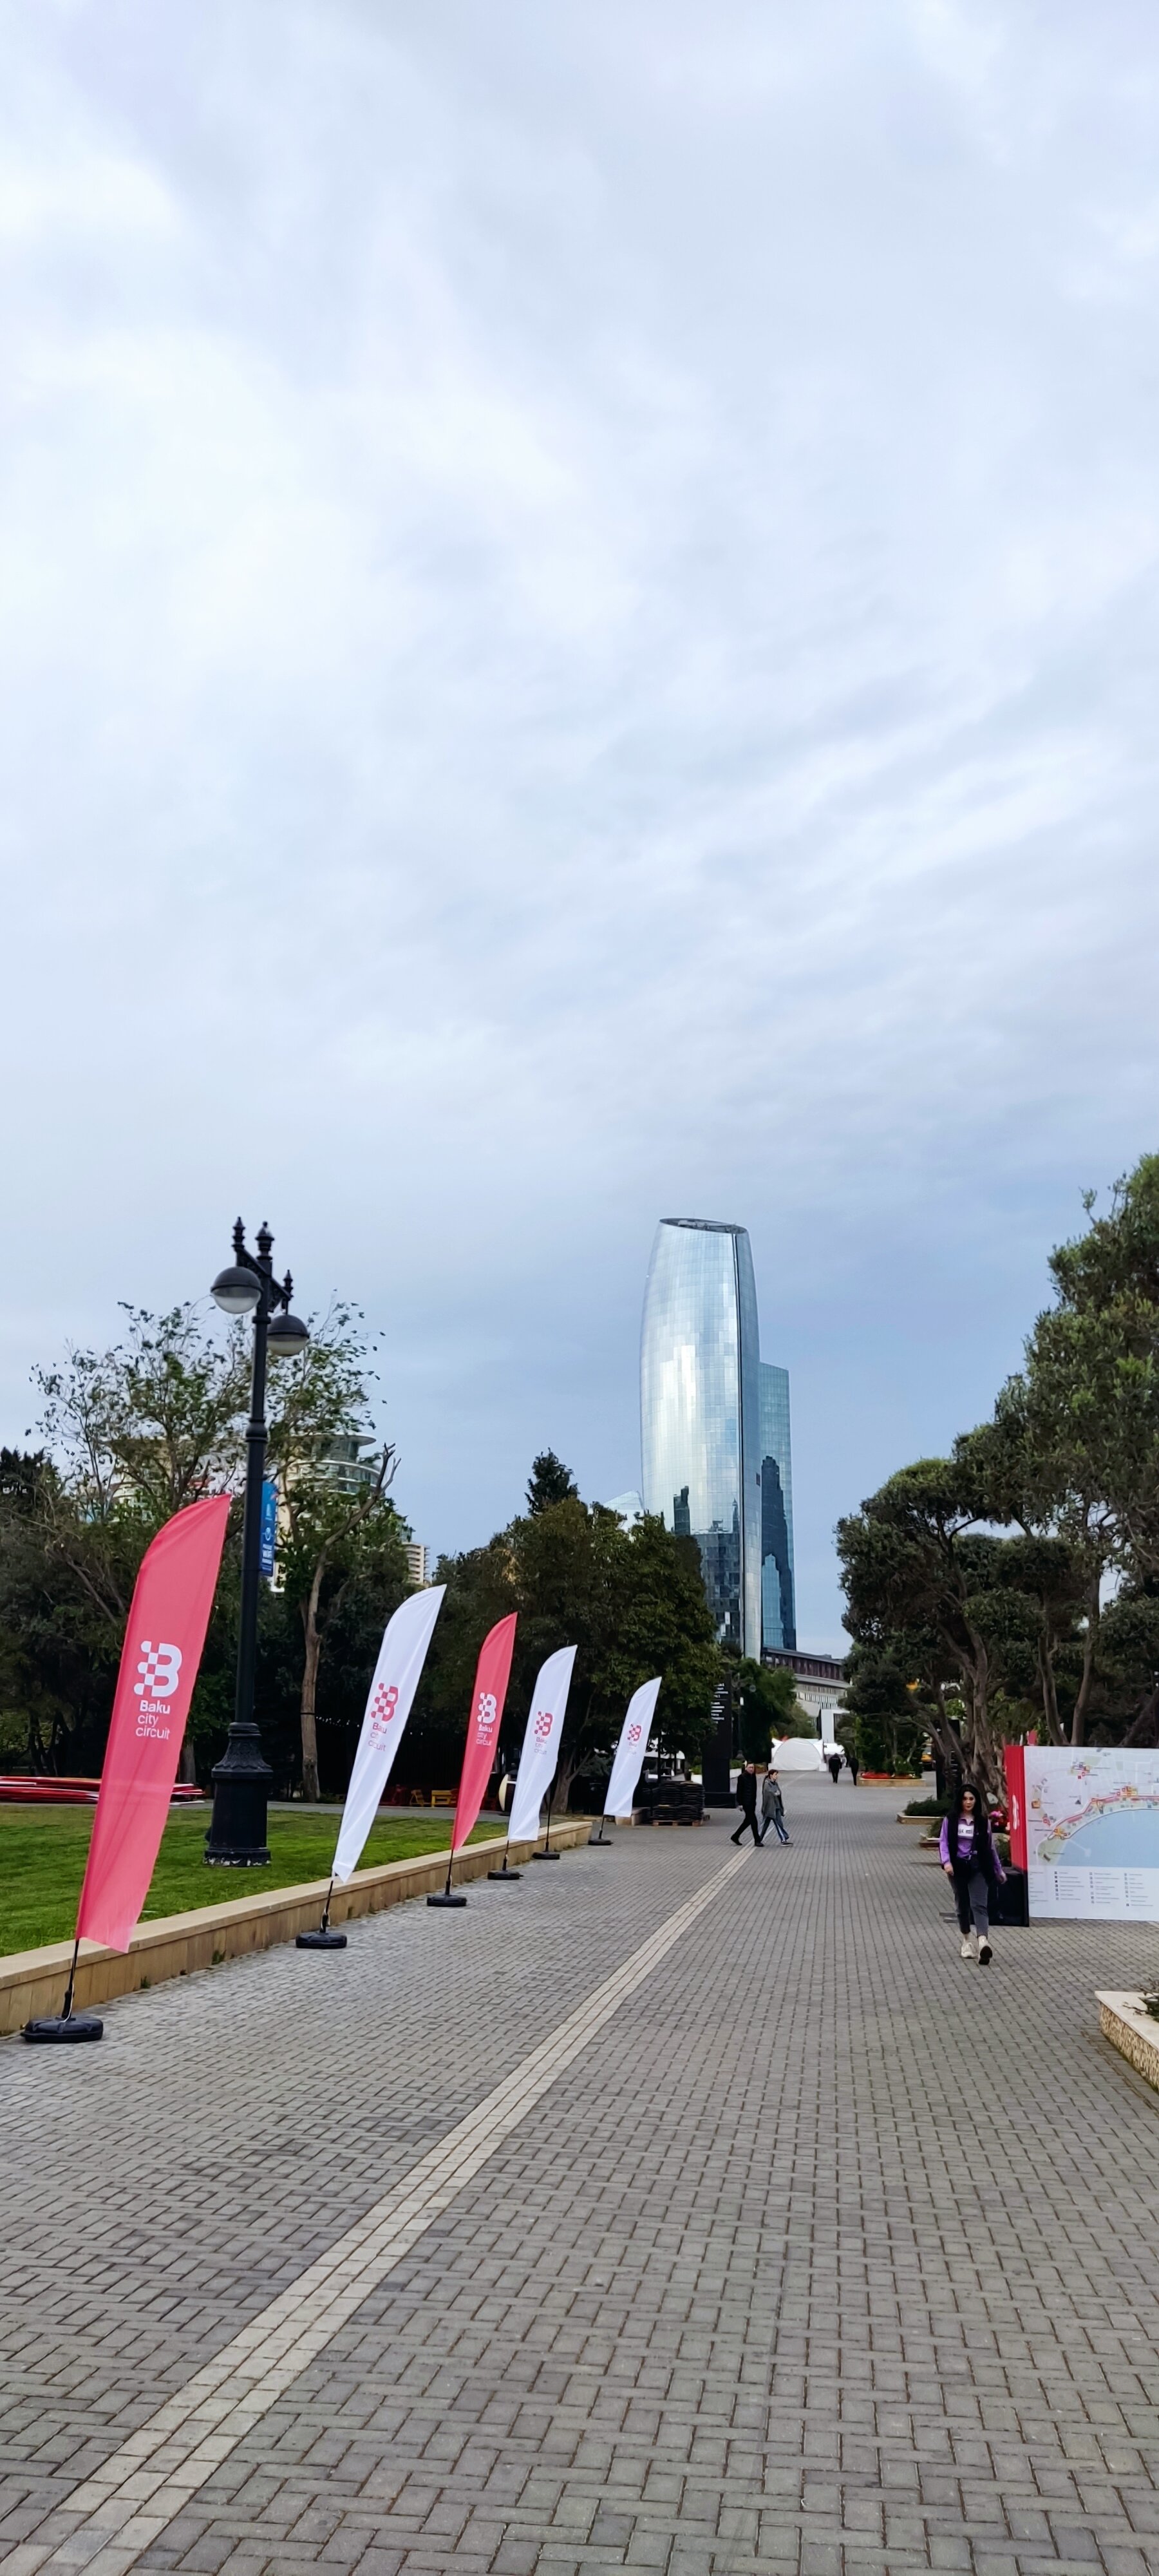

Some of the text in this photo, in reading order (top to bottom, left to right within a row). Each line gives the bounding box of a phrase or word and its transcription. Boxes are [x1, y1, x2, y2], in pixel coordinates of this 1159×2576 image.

[140, 1700, 171, 1714] Baku
[137, 1713, 159, 1727] city
[135, 1725, 171, 1740] circuit
[372, 1722, 387, 1734] Bau
